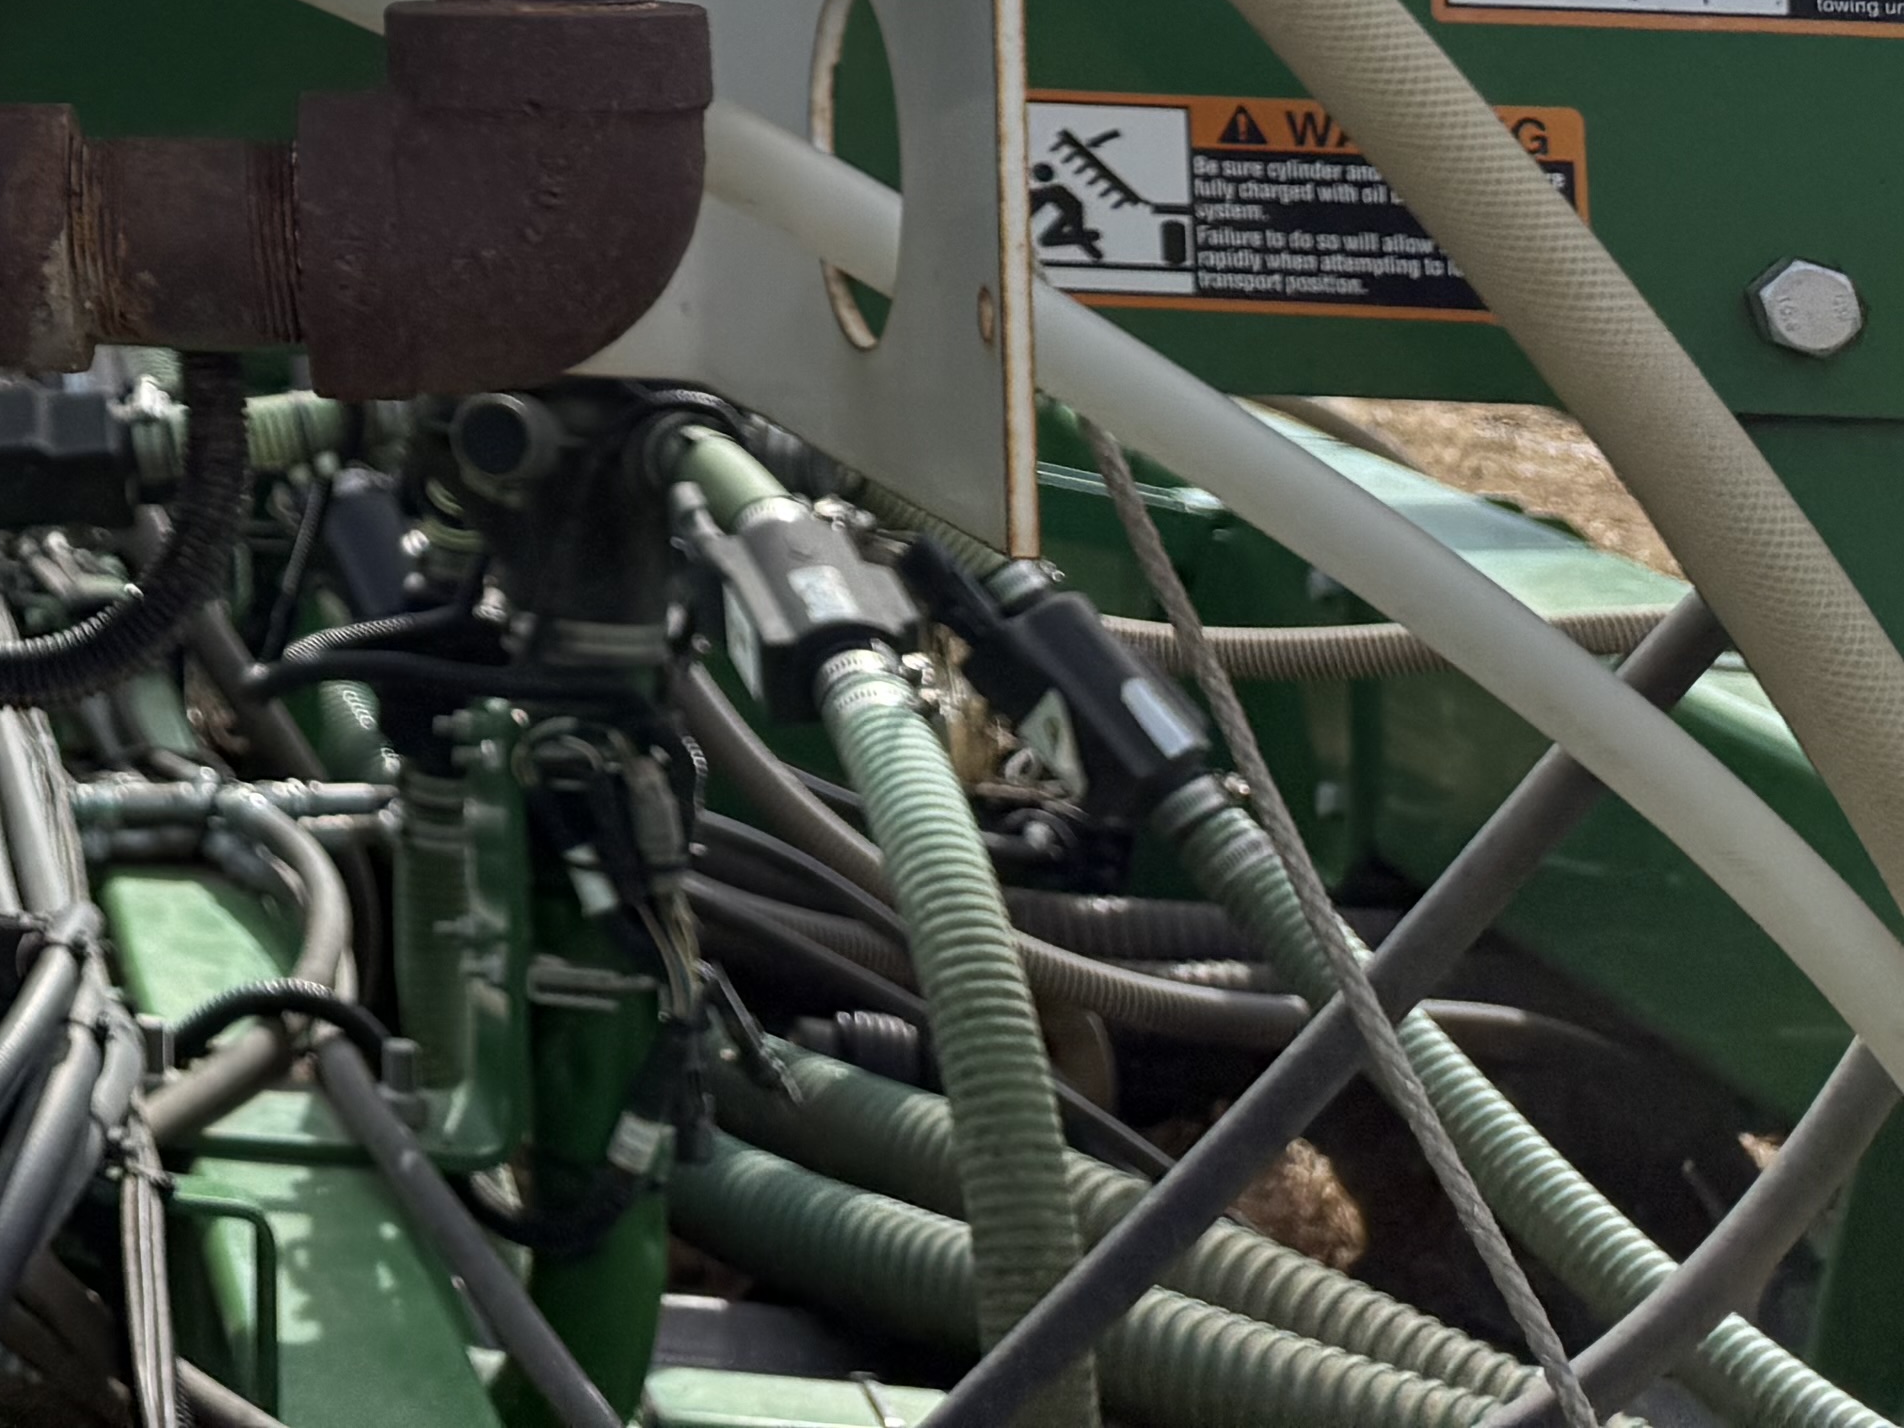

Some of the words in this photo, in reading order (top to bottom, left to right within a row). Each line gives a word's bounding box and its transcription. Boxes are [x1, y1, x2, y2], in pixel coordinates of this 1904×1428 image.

[1193, 155, 1220, 177] Be
[1221, 160, 1264, 177] sure
[1267, 159, 1342, 182] cylinder
[1194, 178, 1238, 200] fully
[1238, 179, 1315, 204] charged
[1317, 182, 1359, 204] with
[1194, 203, 1269, 222] system.
[1197, 224, 1264, 247] Failure
[1266, 229, 1286, 248] to
[1288, 229, 1314, 248] do
[1316, 233, 1341, 250] so
[1343, 231, 1380, 251] will
[1381, 232, 1433, 253] allow
[1197, 249, 1263, 272] rapidly
[1265, 251, 1318, 272] when
[1320, 253, 1421, 279] attempting
[1424, 257, 1444, 276] to
[1197, 270, 1283, 292] transport
